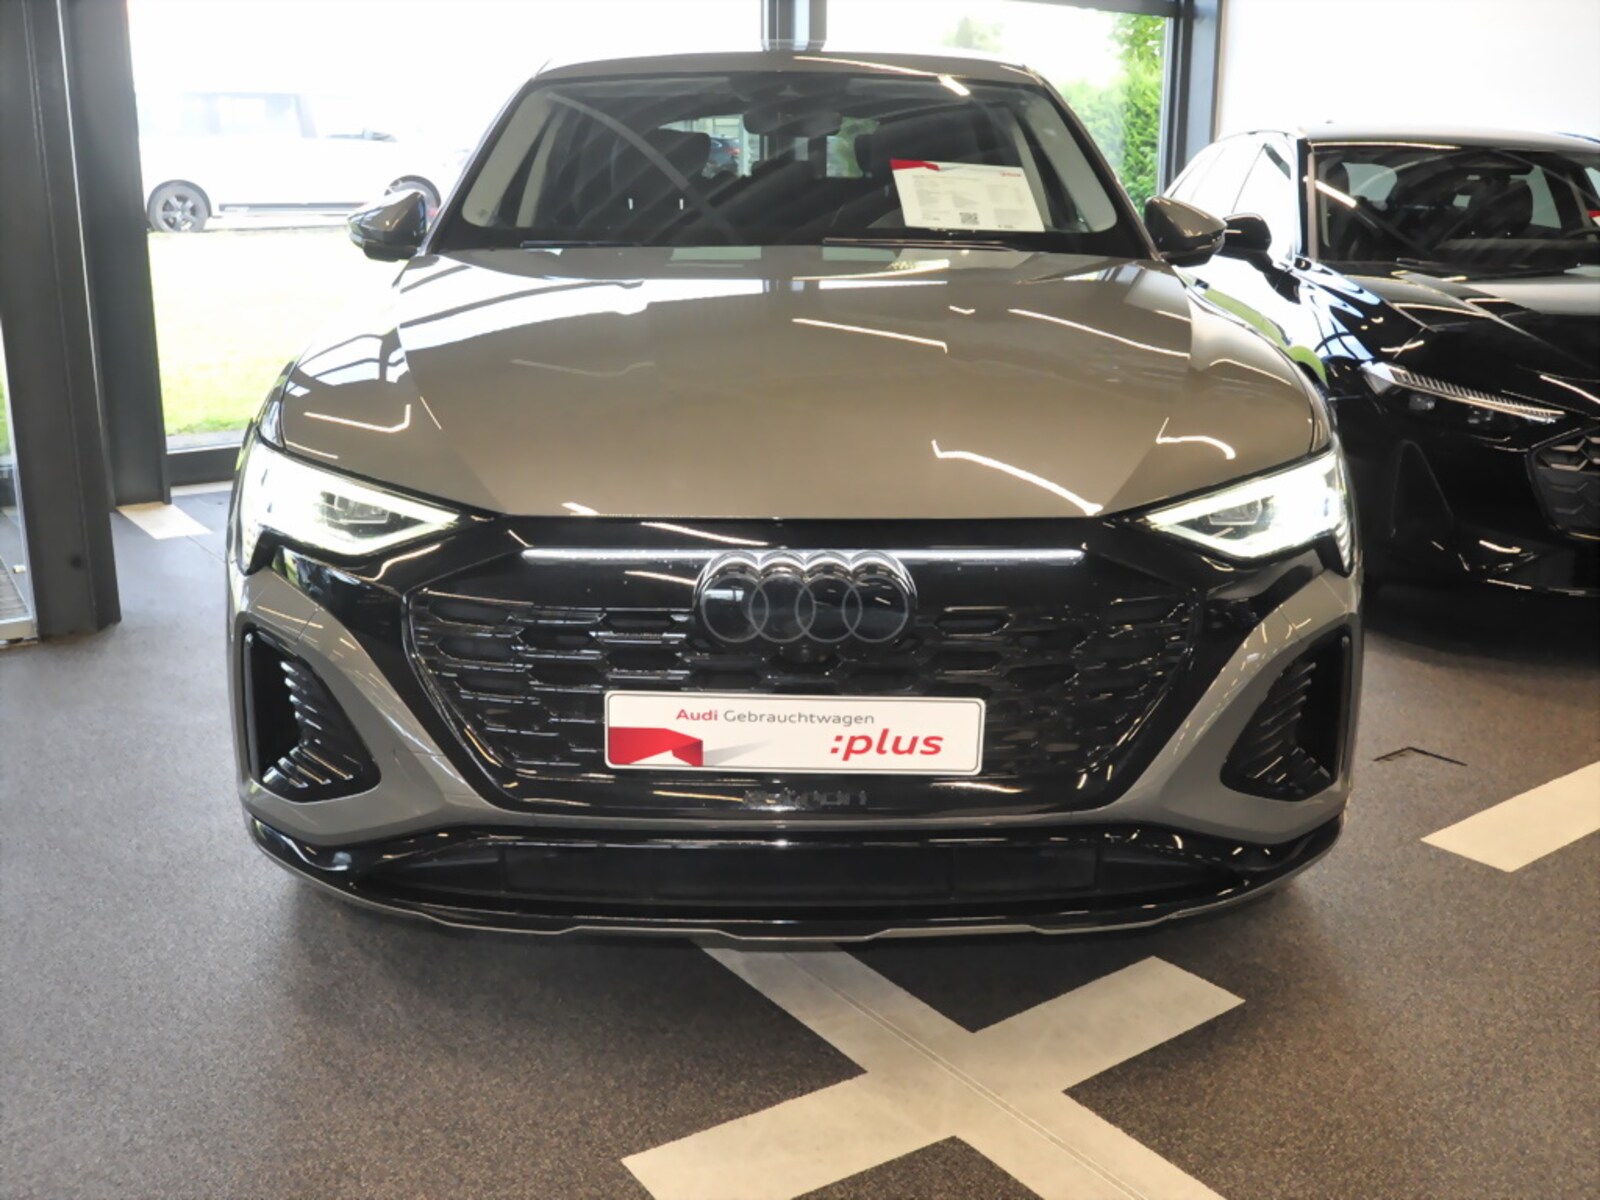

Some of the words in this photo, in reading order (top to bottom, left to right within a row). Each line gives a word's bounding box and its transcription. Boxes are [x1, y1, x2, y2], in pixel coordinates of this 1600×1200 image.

[676, 709, 718, 721] Audi
[723, 710, 875, 727] Gebrauchtwagen
[830, 728, 944, 762] :plus
